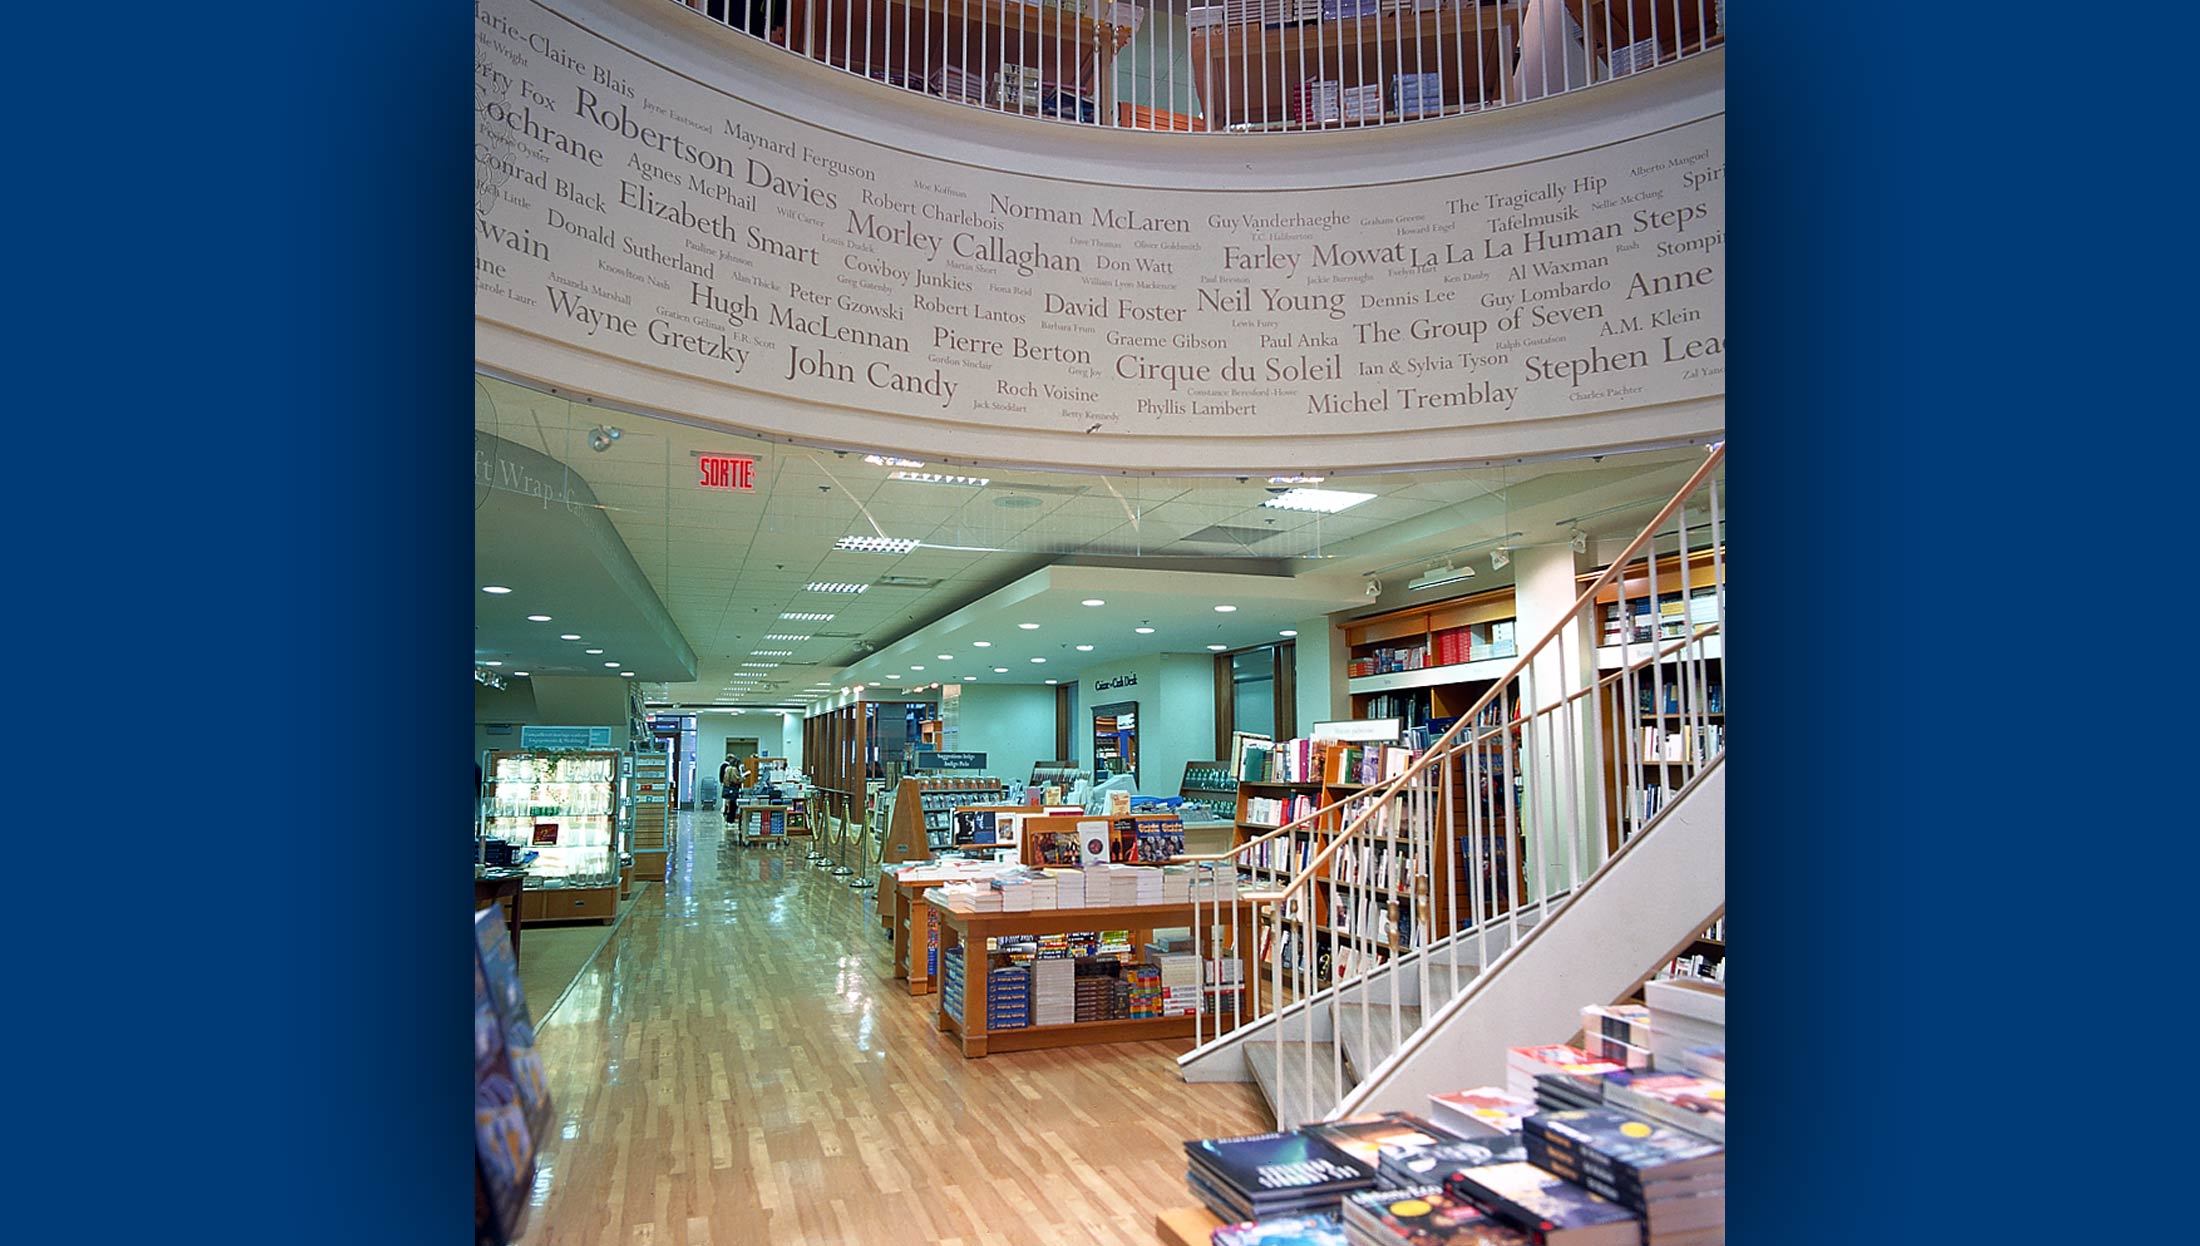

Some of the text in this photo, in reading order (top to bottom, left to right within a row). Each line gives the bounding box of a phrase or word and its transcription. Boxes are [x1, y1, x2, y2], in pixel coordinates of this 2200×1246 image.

[493, 39, 528, 67] Wright
[520, 79, 556, 112] Fox
[592, 63, 636, 99] Blais
[669, 108, 713, 135] Eastwood
[575, 85, 838, 210] Robertson Davies
[723, 118, 876, 181] Maynard Ferguson
[627, 151, 757, 212] Agnes McPhail
[912, 180, 933, 192] Moe
[1628, 163, 1666, 179] Alberto
[555, 176, 607, 215] Black
[861, 188, 1005, 232] Robert Charlebois
[1446, 175, 1608, 215] The Tragically Hip
[619, 180, 820, 267] Elizabeth Smart
[797, 213, 826, 228] Carter
[989, 193, 1191, 234] Norman McLaren
[1207, 210, 1351, 234] Guy Vanderhaeghe
[1486, 204, 1581, 234] Tafelmusik
[547, 207, 715, 281] Donald Sutherland
[846, 208, 1081, 277] Morley Callaghan
[1410, 202, 1709, 269] La La La Human Steps
[598, 258, 671, 291] Knowlton Nash
[843, 254, 973, 293] Cowboy Junkies
[1096, 255, 1174, 275] Don Watt
[1222, 241, 1406, 279] Farley Mowat
[1507, 254, 1610, 282] Al Waxman
[507, 288, 538, 308] Laure
[548, 271, 632, 306] Amanda Marshall
[1360, 288, 1456, 310] Dennis Lee
[1480, 275, 1612, 312] Guy Lombardo
[1626, 265, 1714, 301] Anne
[690, 280, 911, 353] Hugh MacLennan
[789, 282, 905, 322] Peter Gzowski
[913, 294, 1027, 325] Robert Lantos
[1044, 292, 1188, 323] David Foster
[1197, 286, 1346, 320] Neil Young
[545, 285, 750, 374] Wayne Gretzky
[1106, 330, 1228, 349] Graeme Gibson
[1352, 302, 1604, 345] The Group of Seven
[1600, 306, 1702, 338] A.M. Klein
[753, 336, 776, 350] Scott
[932, 325, 1091, 365] Pierre Berton
[1259, 331, 1339, 349] Paul Anka
[783, 344, 959, 409] John Candy
[928, 353, 993, 371] Gordon Sinclair
[1115, 353, 1343, 392] Cirque du Soleil
[1358, 352, 1509, 378] Ian & Sylvia Tyson
[1524, 347, 1649, 388] Stephen
[997, 378, 1100, 403] Roch Voisine
[1307, 380, 1519, 415] Michel Tremblay
[1137, 398, 1257, 420] Phyllis Lambert
[499, 457, 554, 511] Wrap
[700, 457, 754, 490] SORTIE
